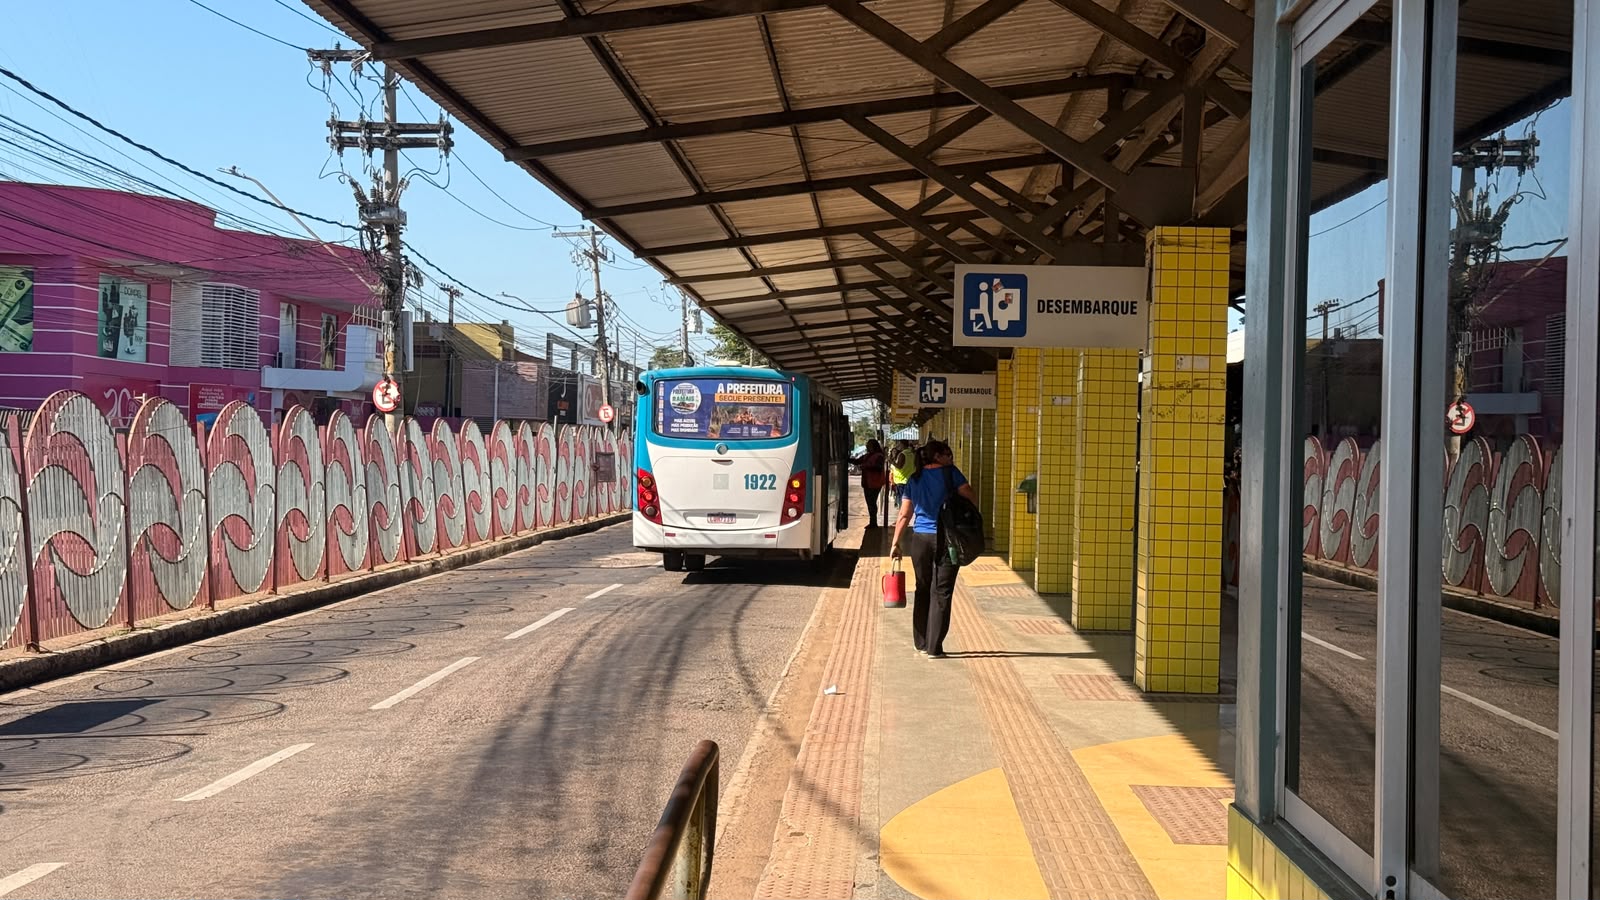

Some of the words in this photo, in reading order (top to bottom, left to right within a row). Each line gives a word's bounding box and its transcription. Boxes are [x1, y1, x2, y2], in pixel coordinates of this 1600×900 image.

[1037, 299, 1138, 316] DESEMBARQUE
[717, 383, 725, 394] A
[727, 383, 784, 395] PREFEITURA
[949, 387, 992, 395] DESEMBARQUE
[743, 395, 782, 403] PRESENTE!
[744, 473, 777, 490] 1922
